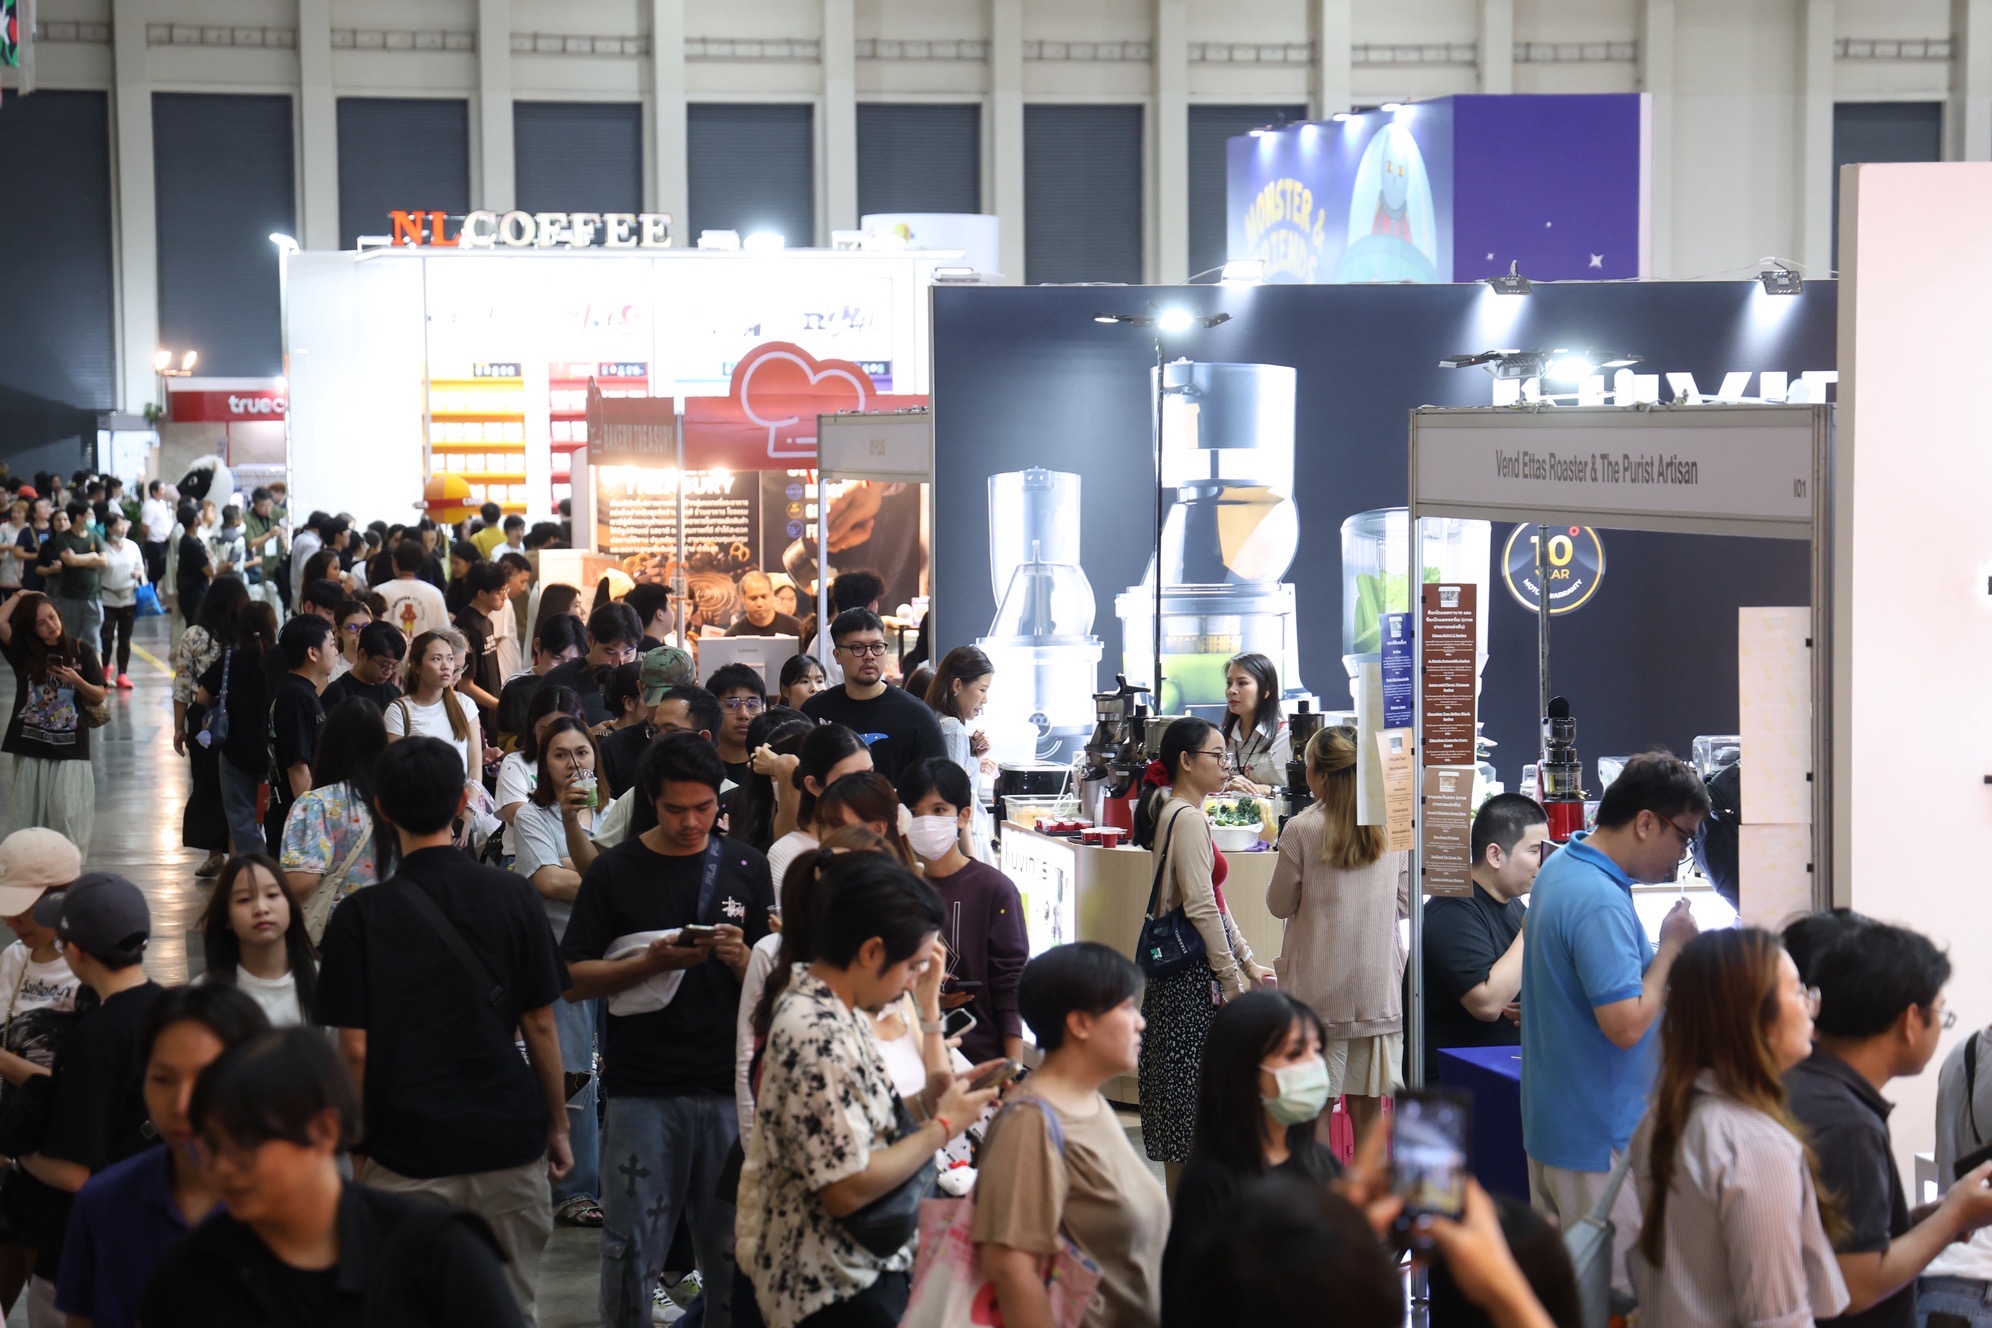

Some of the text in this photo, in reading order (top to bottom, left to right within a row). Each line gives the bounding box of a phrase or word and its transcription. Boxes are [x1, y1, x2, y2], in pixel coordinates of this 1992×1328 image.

[1244, 178, 1312, 254] MONSTER
[603, 423, 673, 454] BAKERY TREASURY
[1496, 449, 1698, 485] Vend Ettas Roaster & The Purist Artisan
[1530, 534, 1574, 567] 10
[705, 863, 717, 886] FILA
